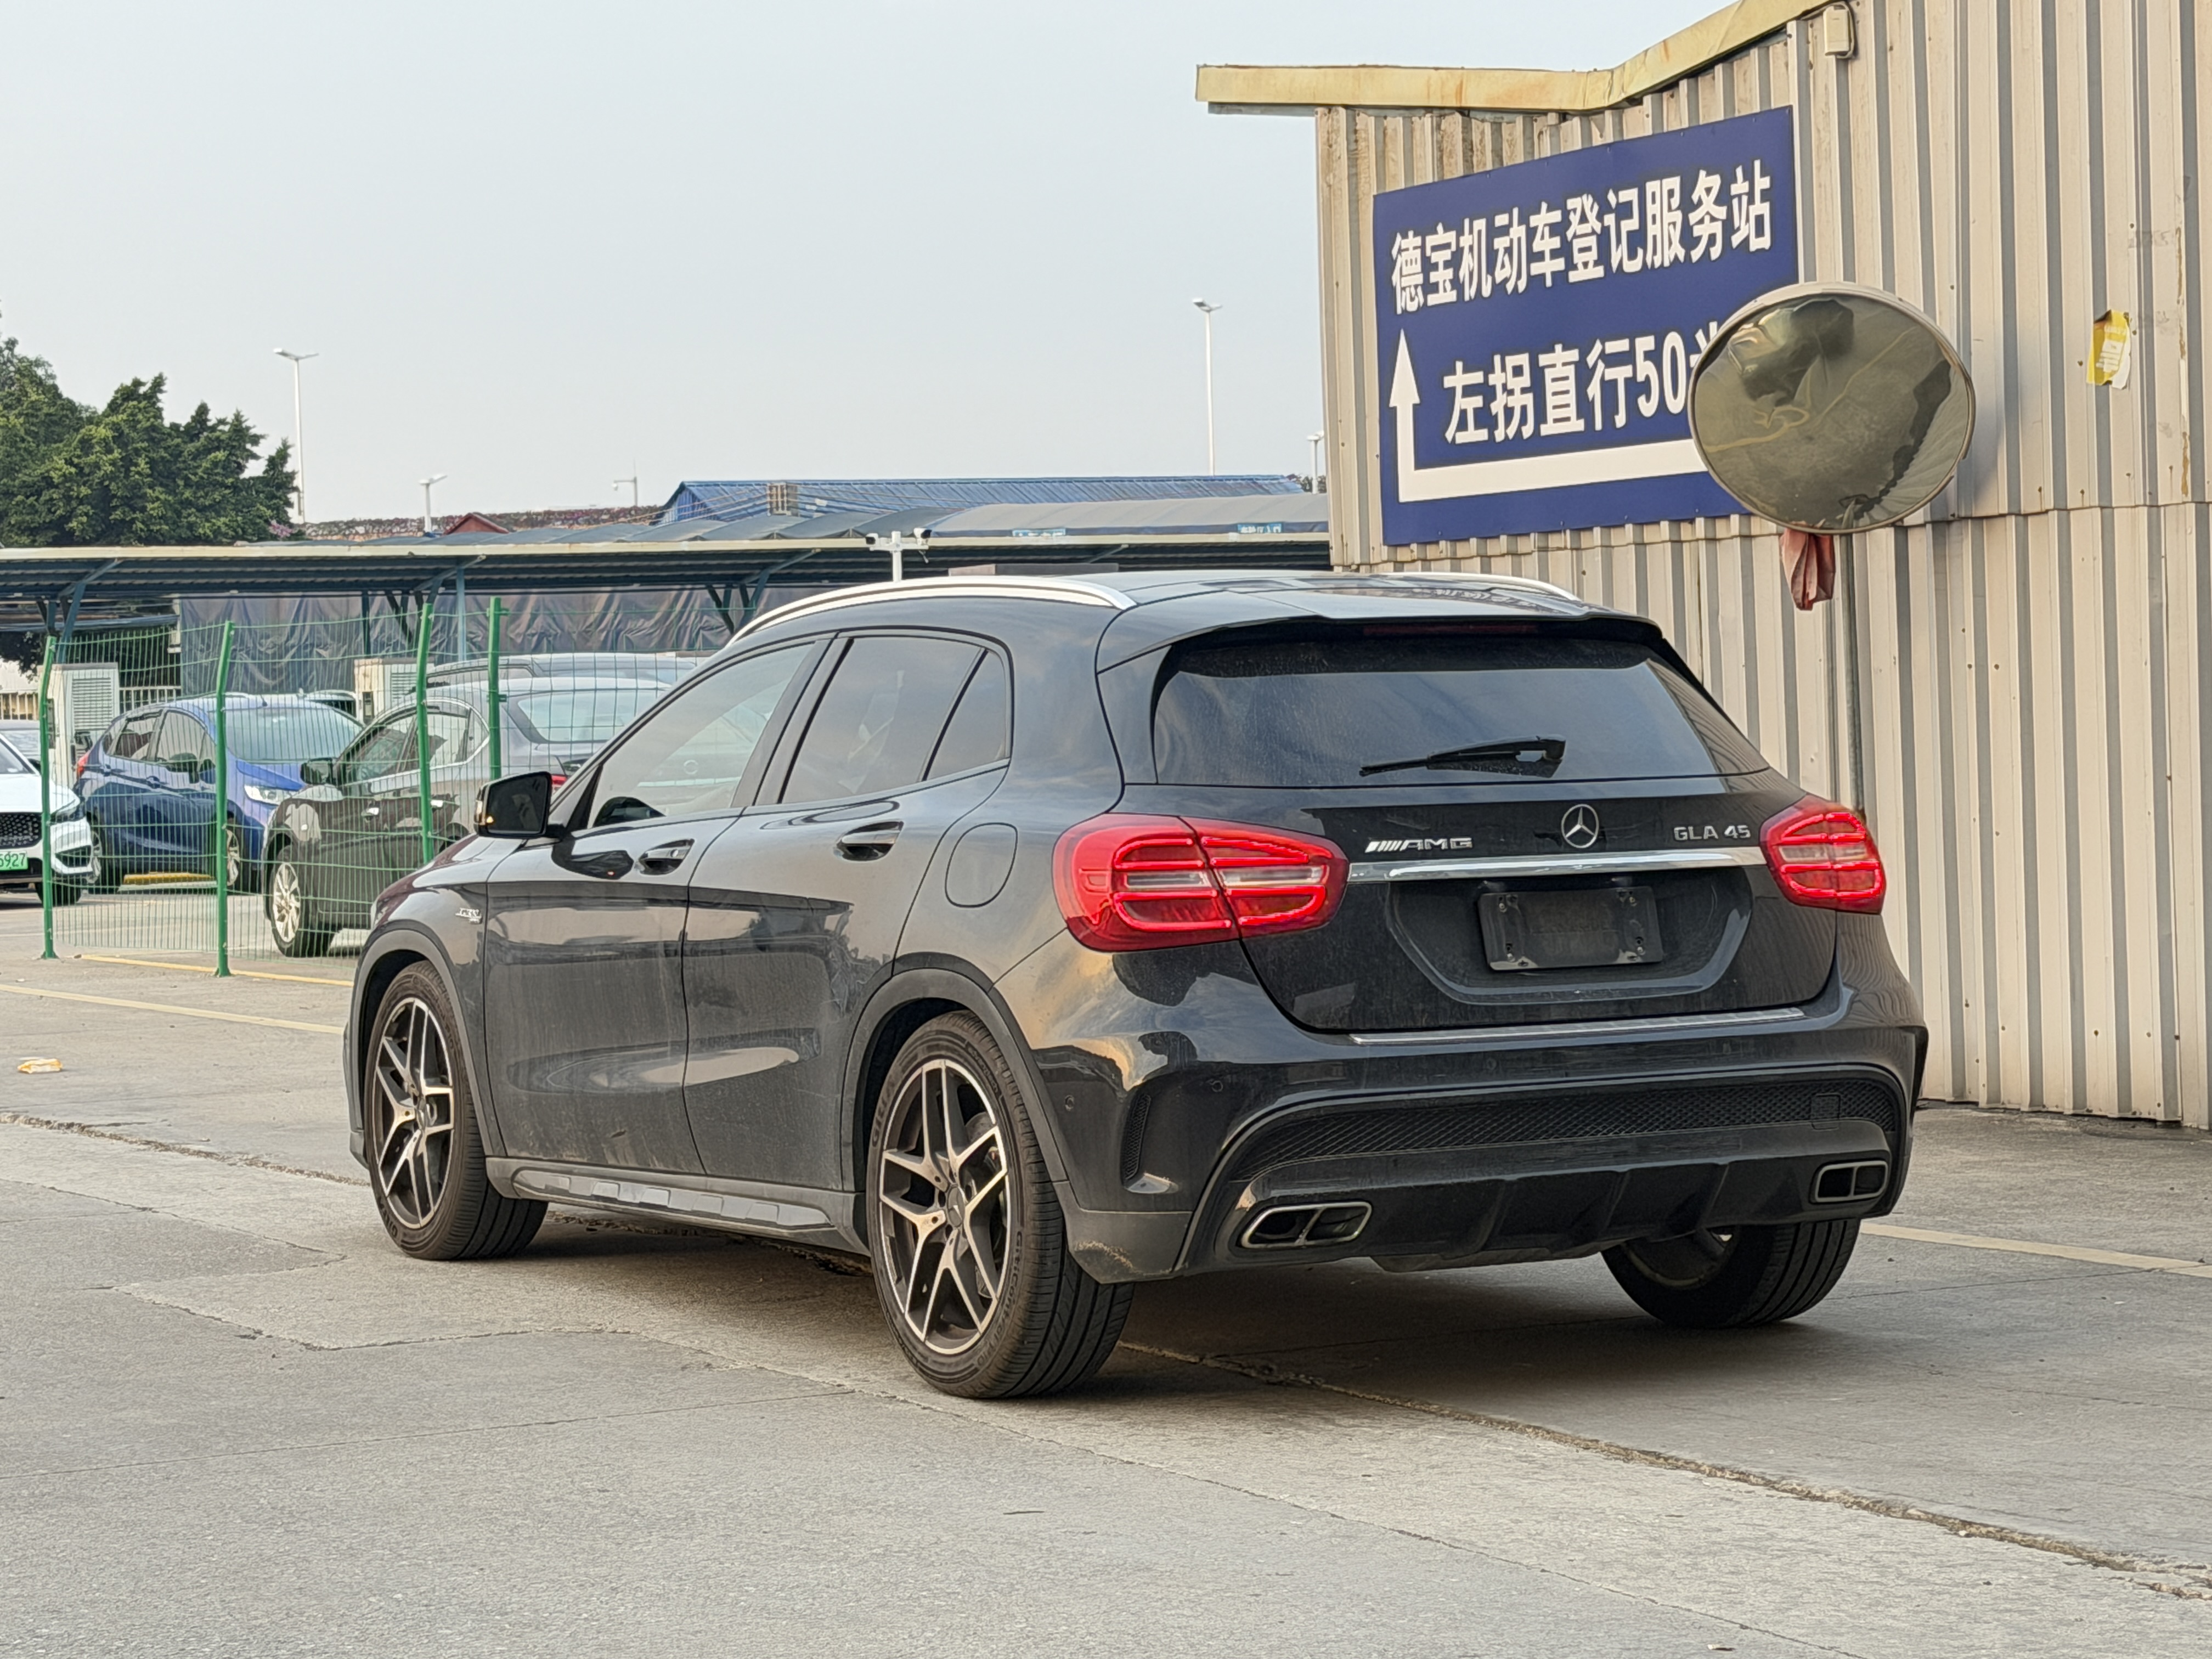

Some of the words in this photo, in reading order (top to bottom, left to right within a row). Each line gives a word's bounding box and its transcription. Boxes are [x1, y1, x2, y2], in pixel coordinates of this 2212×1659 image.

[1391, 159, 1771, 314] 德宝机动车登记服务站
[1673, 825, 1719, 840] GLA
[1724, 825, 1751, 839] 45
[1398, 837, 1473, 851] AMG
